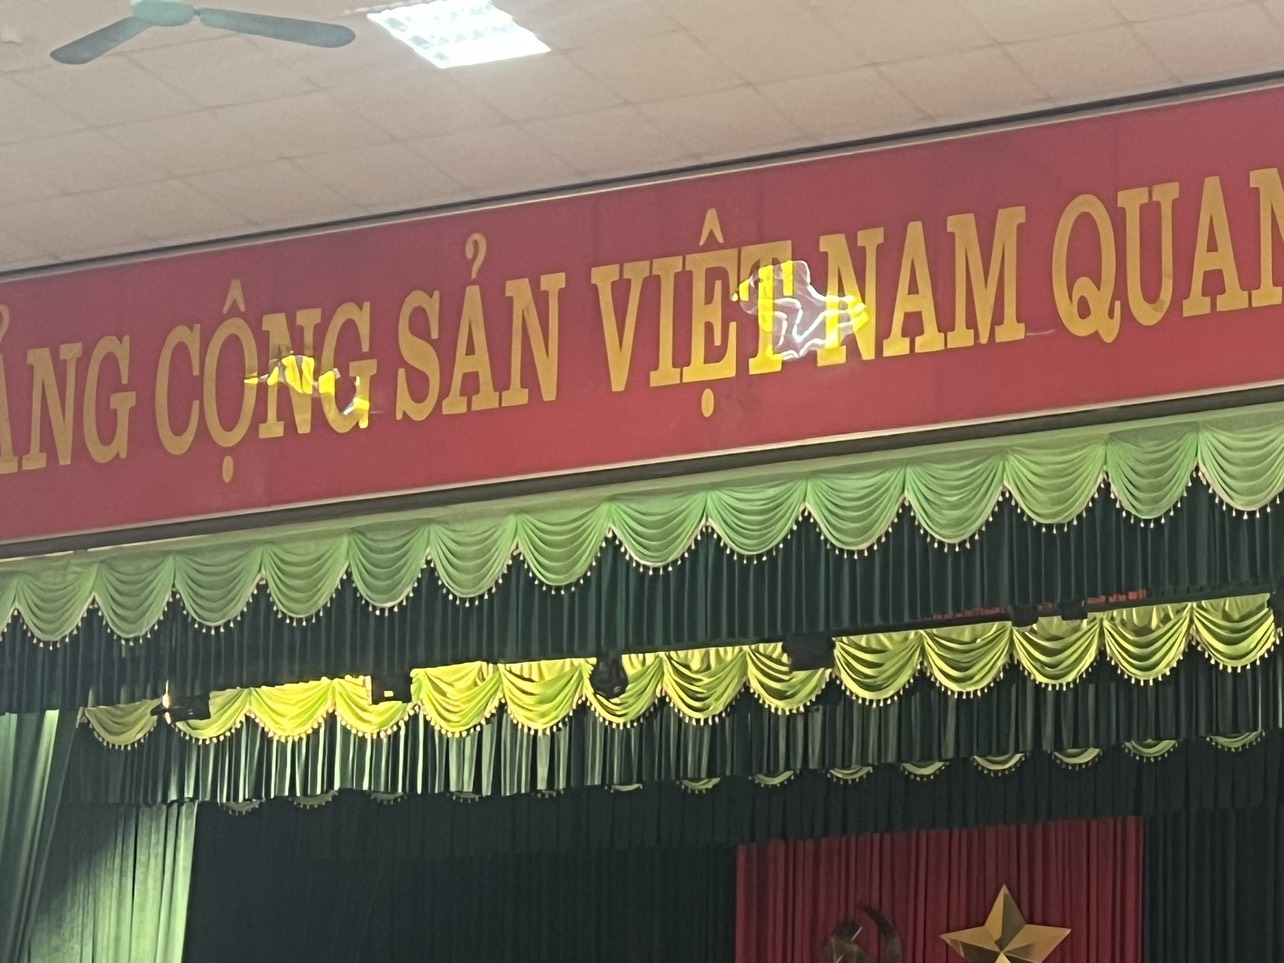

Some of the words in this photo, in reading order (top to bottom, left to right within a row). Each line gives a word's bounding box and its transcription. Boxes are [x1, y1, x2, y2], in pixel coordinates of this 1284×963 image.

[155, 279, 378, 483] CỘNG
[396, 232, 566, 421] SẢN
[591, 208, 792, 418] VIỆT
[817, 205, 1026, 367] NAM
